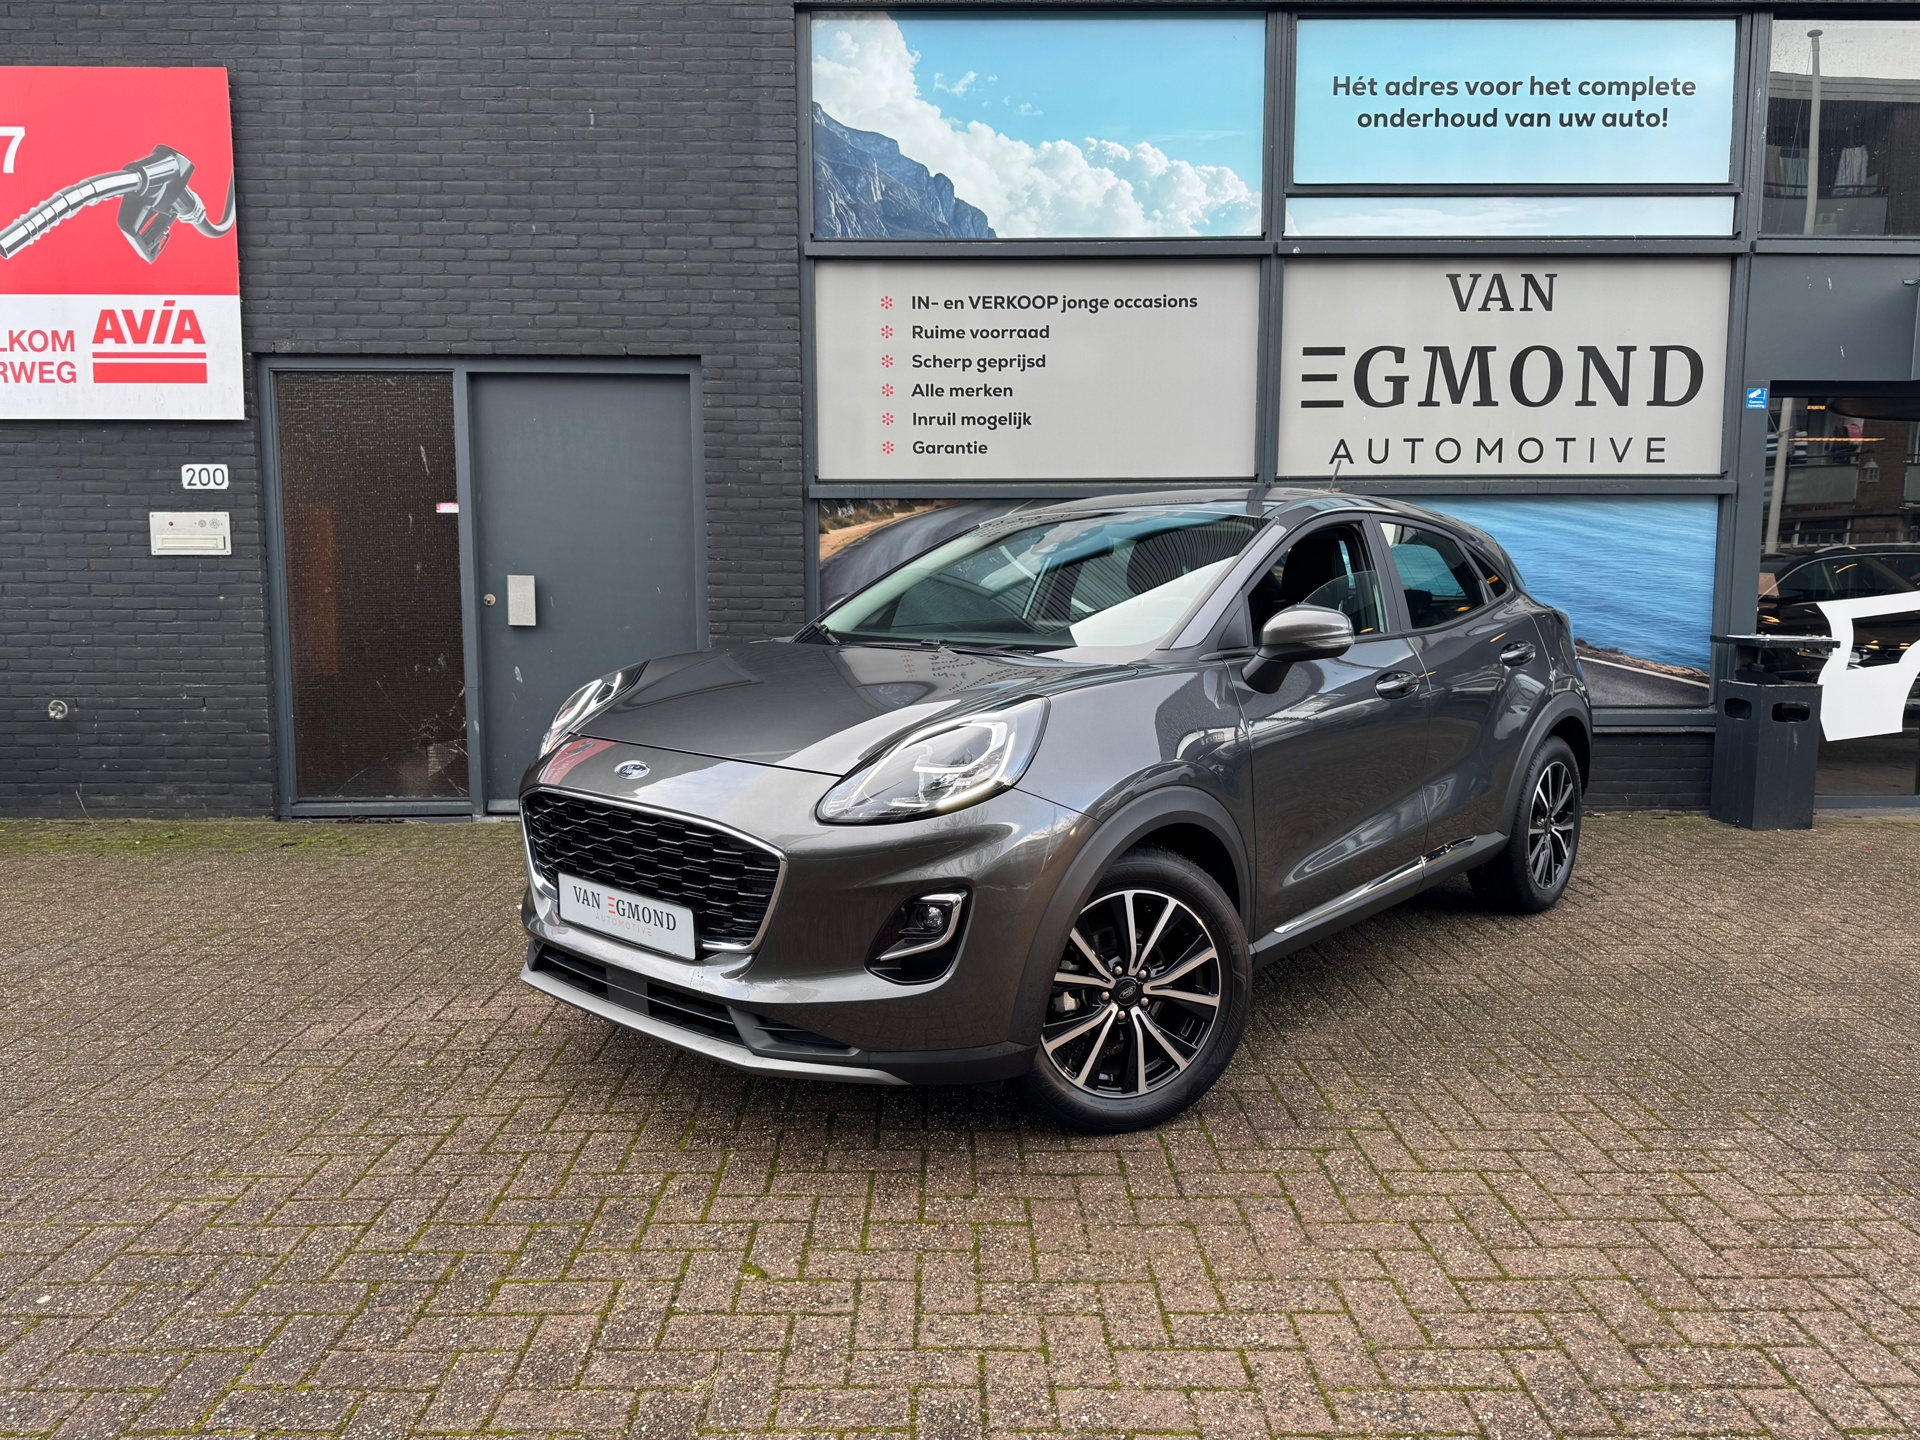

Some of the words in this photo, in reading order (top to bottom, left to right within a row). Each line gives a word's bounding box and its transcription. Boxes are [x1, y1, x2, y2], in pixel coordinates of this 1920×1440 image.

[1333, 75, 1377, 96] Hét
[1385, 76, 1458, 96] adres
[1465, 81, 1523, 96] voor
[1529, 76, 1571, 96] het
[1578, 76, 1696, 102] complete
[1357, 108, 1498, 128] onderhoud
[1504, 112, 1551, 128] van
[1558, 112, 1596, 128] uw
[1601, 108, 1668, 128] auto!
[1446, 273, 1558, 312] VAN
[911, 295, 938, 310] IN-
[944, 299, 965, 310] en
[969, 295, 1059, 310] VERKOOP
[1061, 295, 1109, 314] jonge
[1114, 294, 1198, 309] occasions
[912, 324, 966, 339] Ruime
[970, 324, 1050, 339] voorraad
[912, 354, 972, 372] Scherp
[976, 354, 1046, 373] geprijsd
[1301, 345, 1704, 409] EGMOND
[912, 383, 945, 398] Alle
[949, 383, 1013, 398] merken
[912, 412, 956, 426] Inruil
[961, 412, 1032, 431] mogelijk
[912, 440, 988, 455] Garantie
[1328, 437, 1666, 465] AUTOMOTIVE
[185, 467, 225, 487] 200
[573, 885, 601, 910] VAN
[608, 896, 677, 931] EGMOND
[595, 912, 652, 937] AUTOMOTIVE
